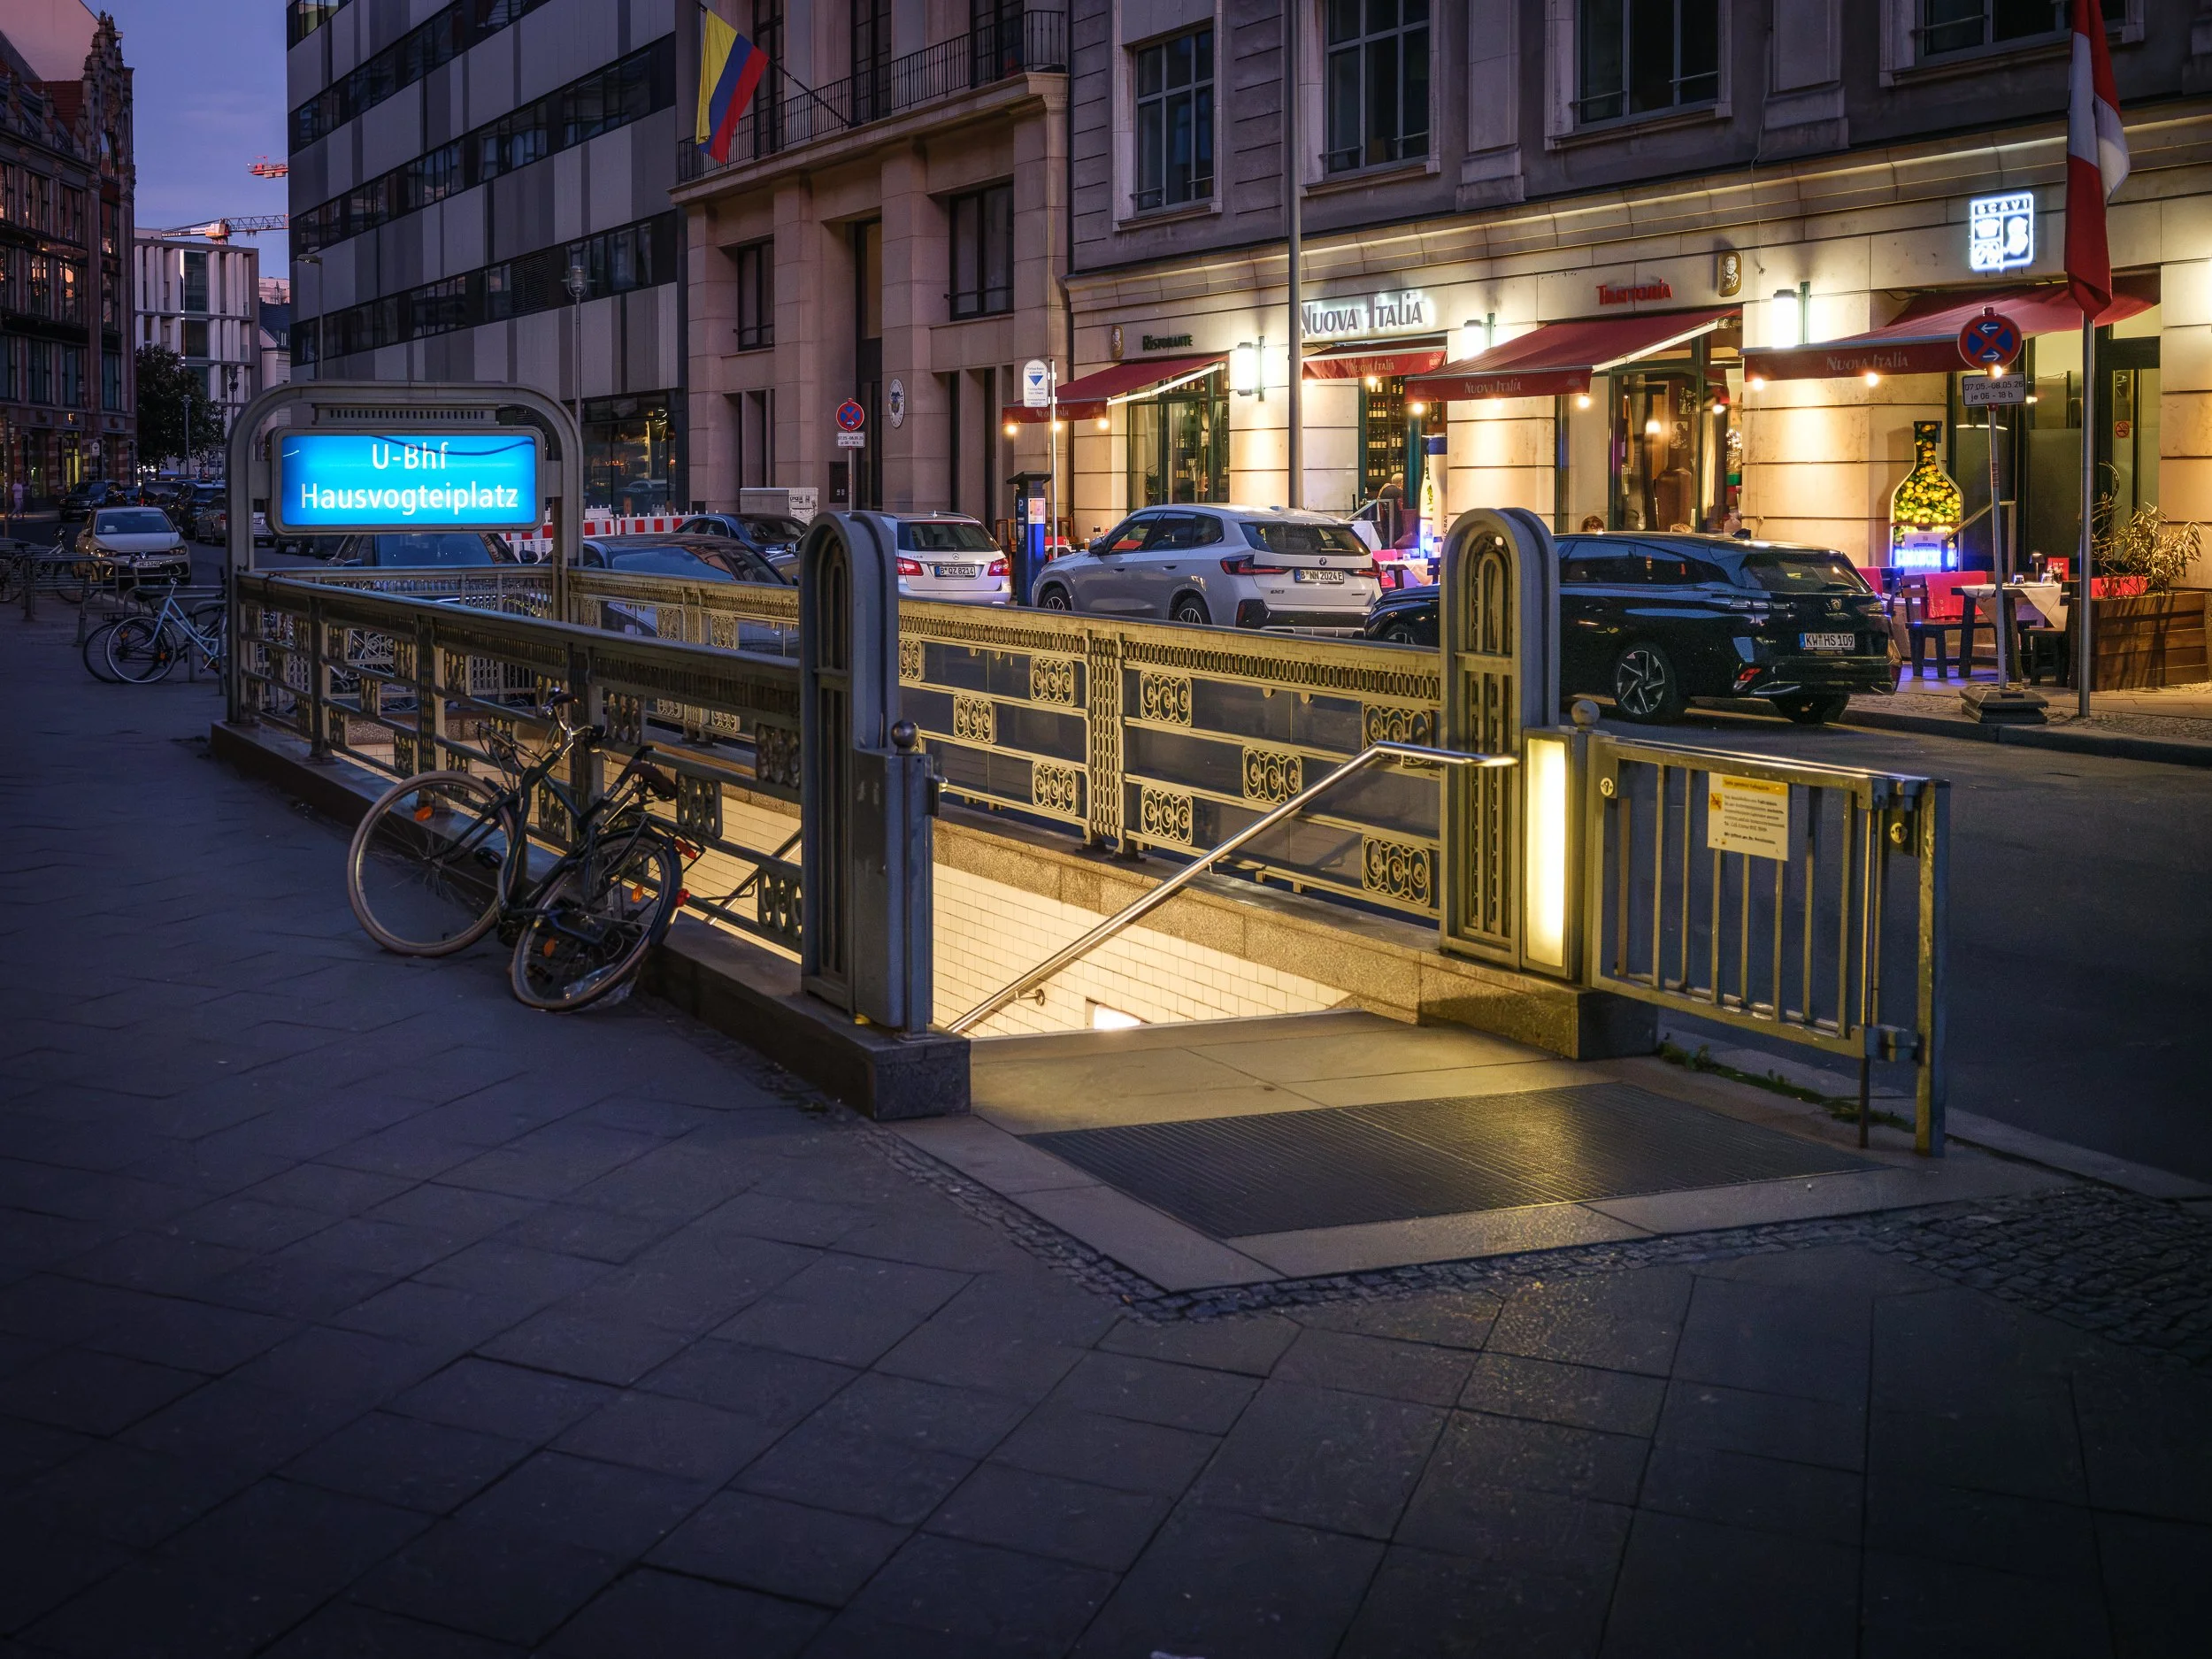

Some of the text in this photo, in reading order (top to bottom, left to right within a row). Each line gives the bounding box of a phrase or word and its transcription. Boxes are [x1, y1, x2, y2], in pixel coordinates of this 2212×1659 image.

[1970, 394, 1978, 403] je
[372, 441, 449, 470] U-Bhf
[301, 480, 518, 516] Hausvogteiplatz
[1018, 499, 1024, 511] P
[1301, 571, 1306, 580] B
[1310, 571, 1320, 580] NN
[1806, 634, 1855, 647] KW HS 109
